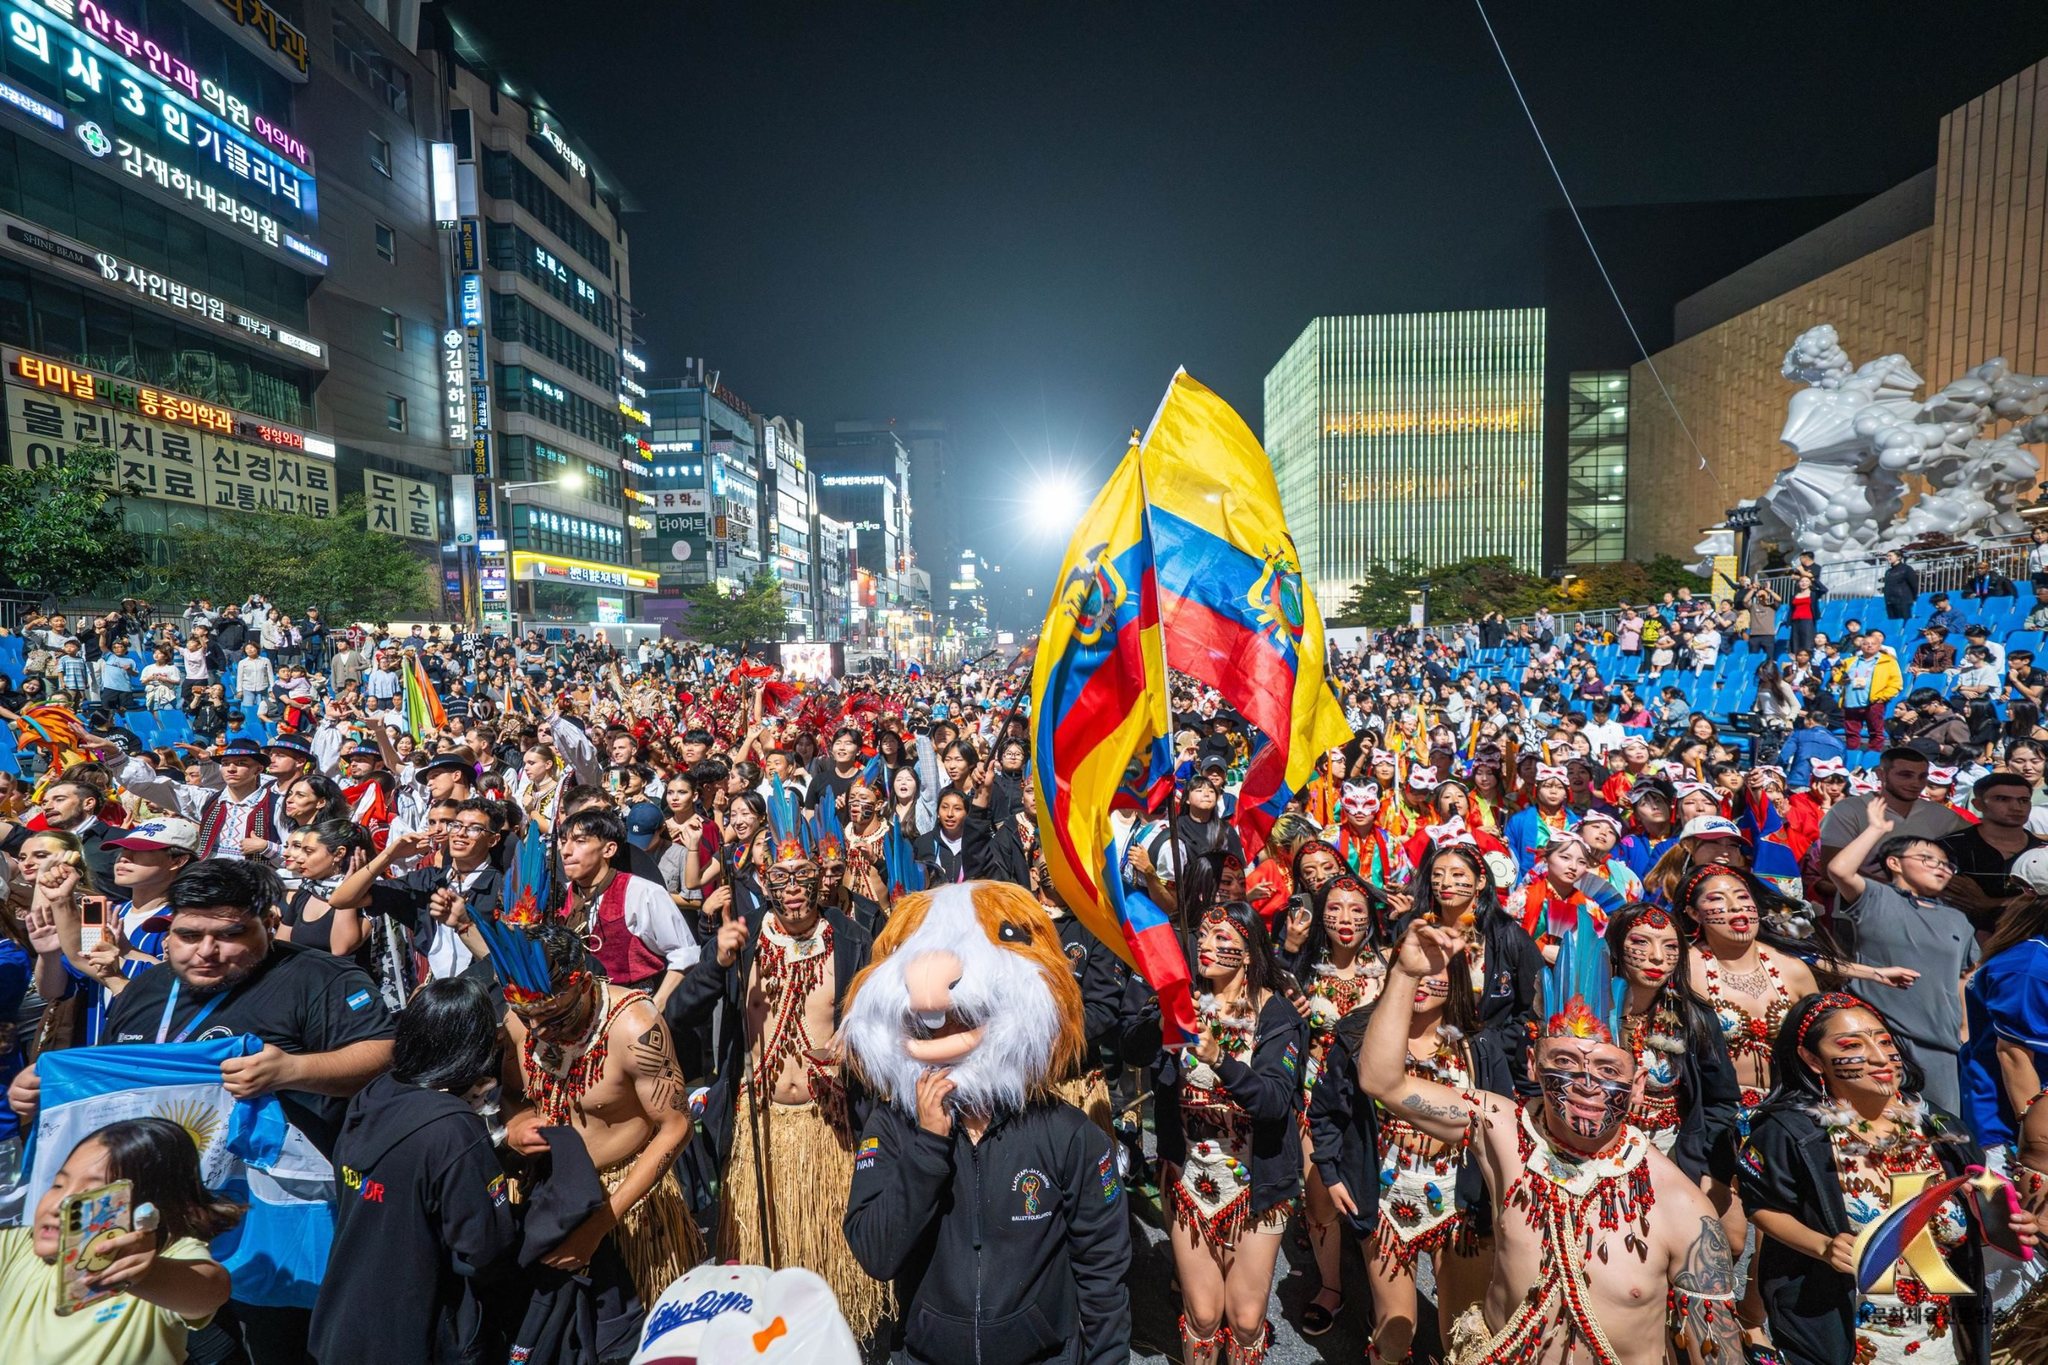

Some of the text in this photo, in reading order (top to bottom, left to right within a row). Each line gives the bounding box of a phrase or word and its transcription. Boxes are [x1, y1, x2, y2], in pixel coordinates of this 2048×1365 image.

[11, 12, 102, 93] 의사
[222, 0, 307, 73] 치과
[255, 116, 306, 164] 여의사
[116, 138, 279, 248] 김재하내과의원
[442, 221, 454, 229] 7F
[23, 232, 84, 264] SHINE BEAM
[125, 267, 225, 323] 샤인빔의원
[238, 314, 272, 339] 피부과
[446, 349, 468, 440] 김재하내과
[23, 399, 194, 464] 물리치료
[258, 425, 304, 449] 정형외과
[212, 447, 329, 492] 신경치료
[215, 480, 330, 519] 교통사고치료
[373, 475, 431, 510] 도수
[374, 504, 432, 537] 치료
[459, 534, 471, 542] 3F
[659, 516, 706, 532] 다이어트
[856, 1157, 875, 1171] IVAN
[342, 1165, 385, 1203] ECUOR
